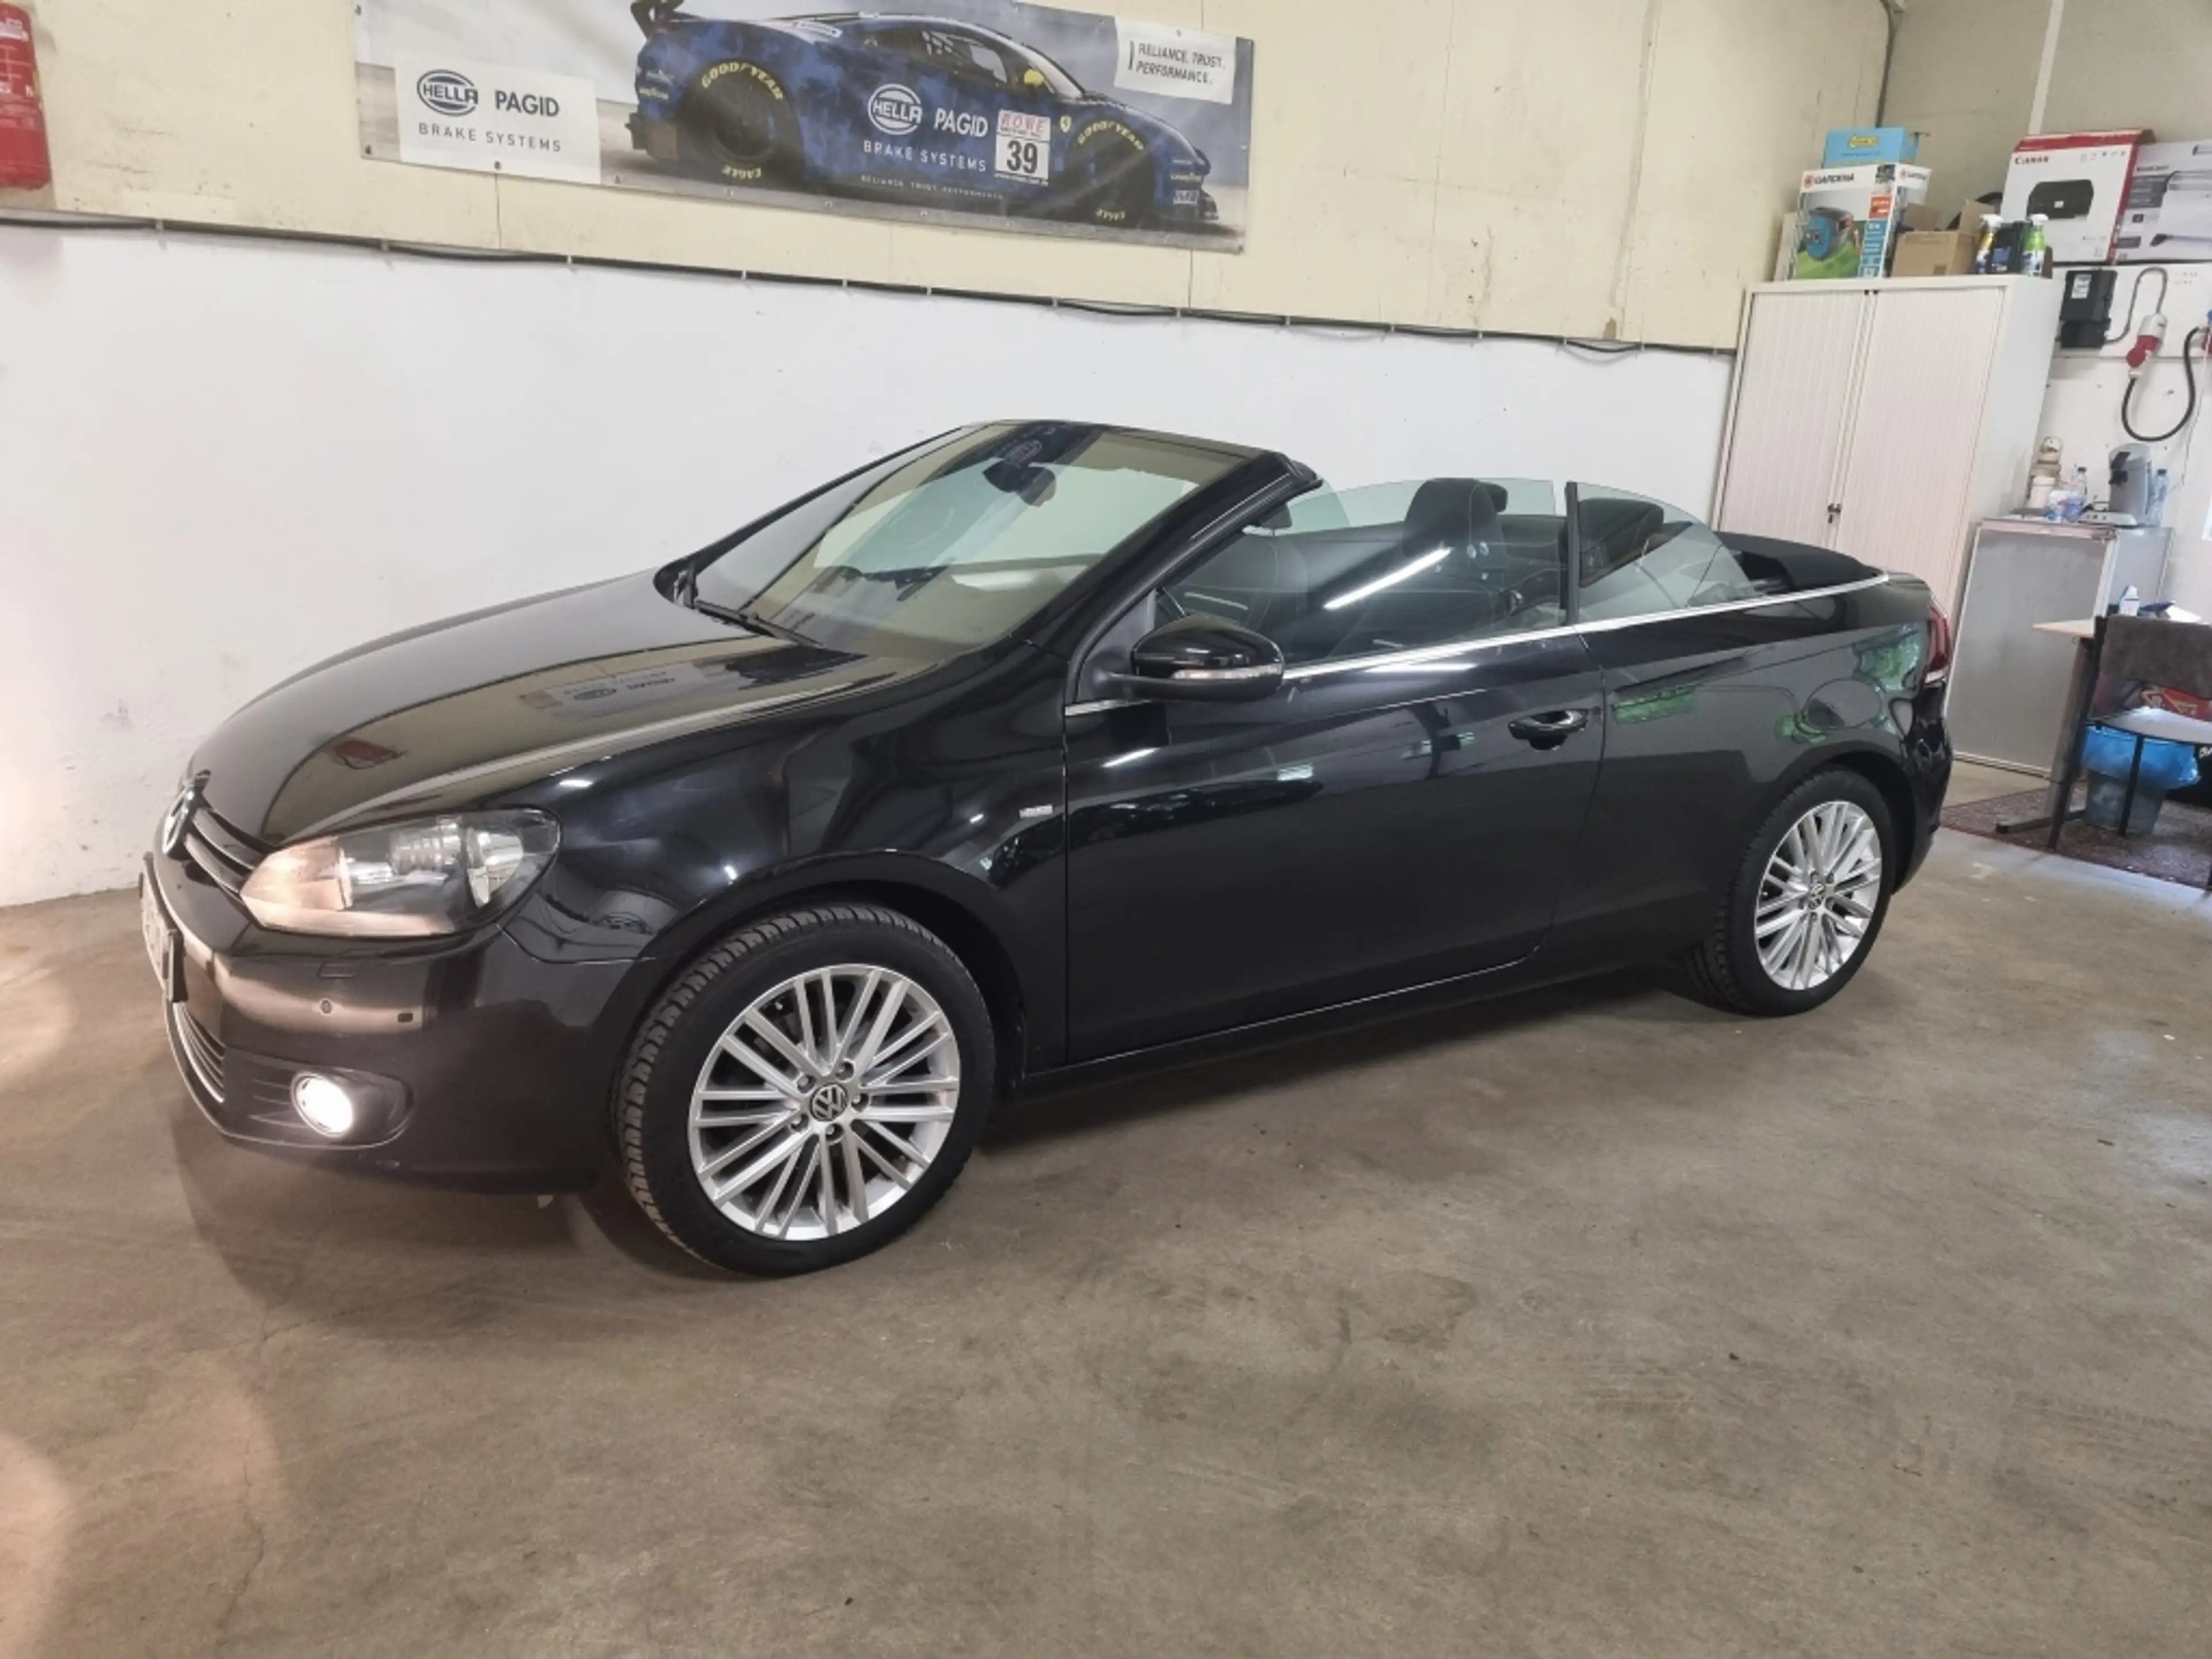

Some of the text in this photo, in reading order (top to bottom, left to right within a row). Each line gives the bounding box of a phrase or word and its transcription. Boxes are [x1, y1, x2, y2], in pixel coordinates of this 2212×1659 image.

[423, 83, 479, 105] HELLA
[494, 89, 560, 118] PAGID
[872, 99, 923, 124] HELLA
[933, 107, 988, 138] PAGID
[418, 122, 562, 152] BRAKE SYSTEMS
[863, 139, 986, 172] BRAKE SYSTEMS
[1006, 139, 1038, 174] 39
